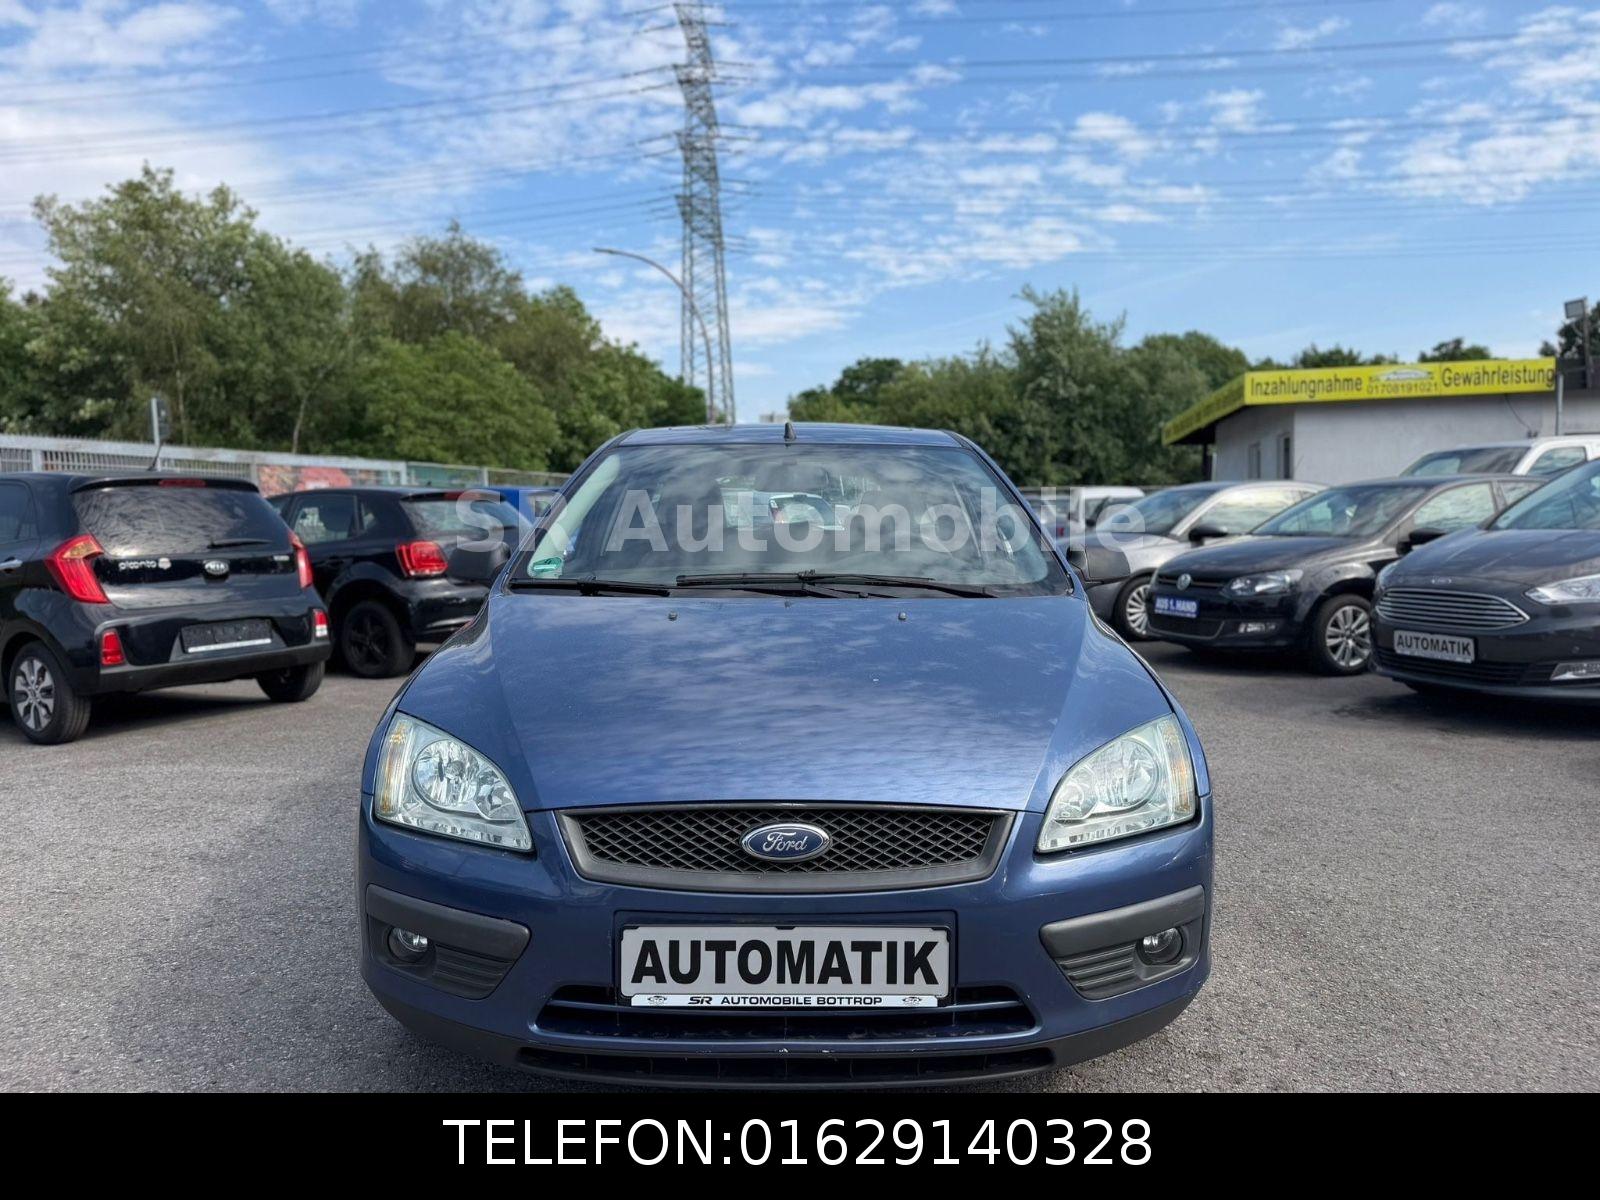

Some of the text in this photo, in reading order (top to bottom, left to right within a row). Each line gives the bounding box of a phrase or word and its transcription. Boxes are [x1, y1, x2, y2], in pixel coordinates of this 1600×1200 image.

[1251, 374, 1363, 398] Inzahlungnahme
[1442, 365, 1555, 387] Gewährleistung
[1397, 634, 1472, 656] AUTOMATIK
[762, 831, 809, 852] Ford
[630, 939, 940, 985] AUTOMATIK
[688, 996, 883, 1006] SR AUTOMOBILE BOTTROP
